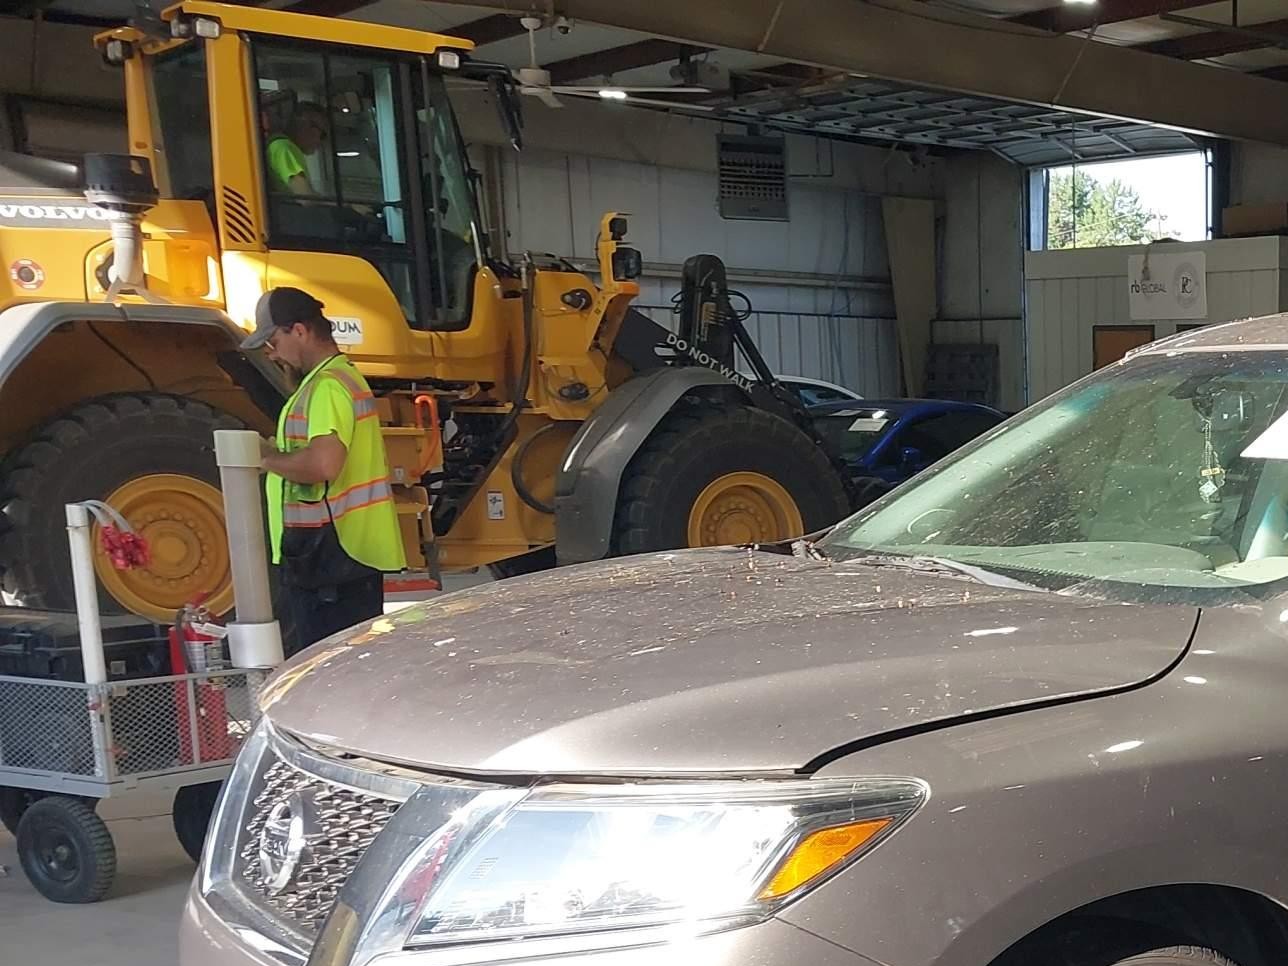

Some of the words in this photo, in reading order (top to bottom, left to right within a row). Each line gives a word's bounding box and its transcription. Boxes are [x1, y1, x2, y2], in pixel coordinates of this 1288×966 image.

[0, 204, 114, 221] VOLVO
[666, 333, 688, 351] DO
[688, 346, 719, 370] NOT
[720, 364, 755, 393] WALK
